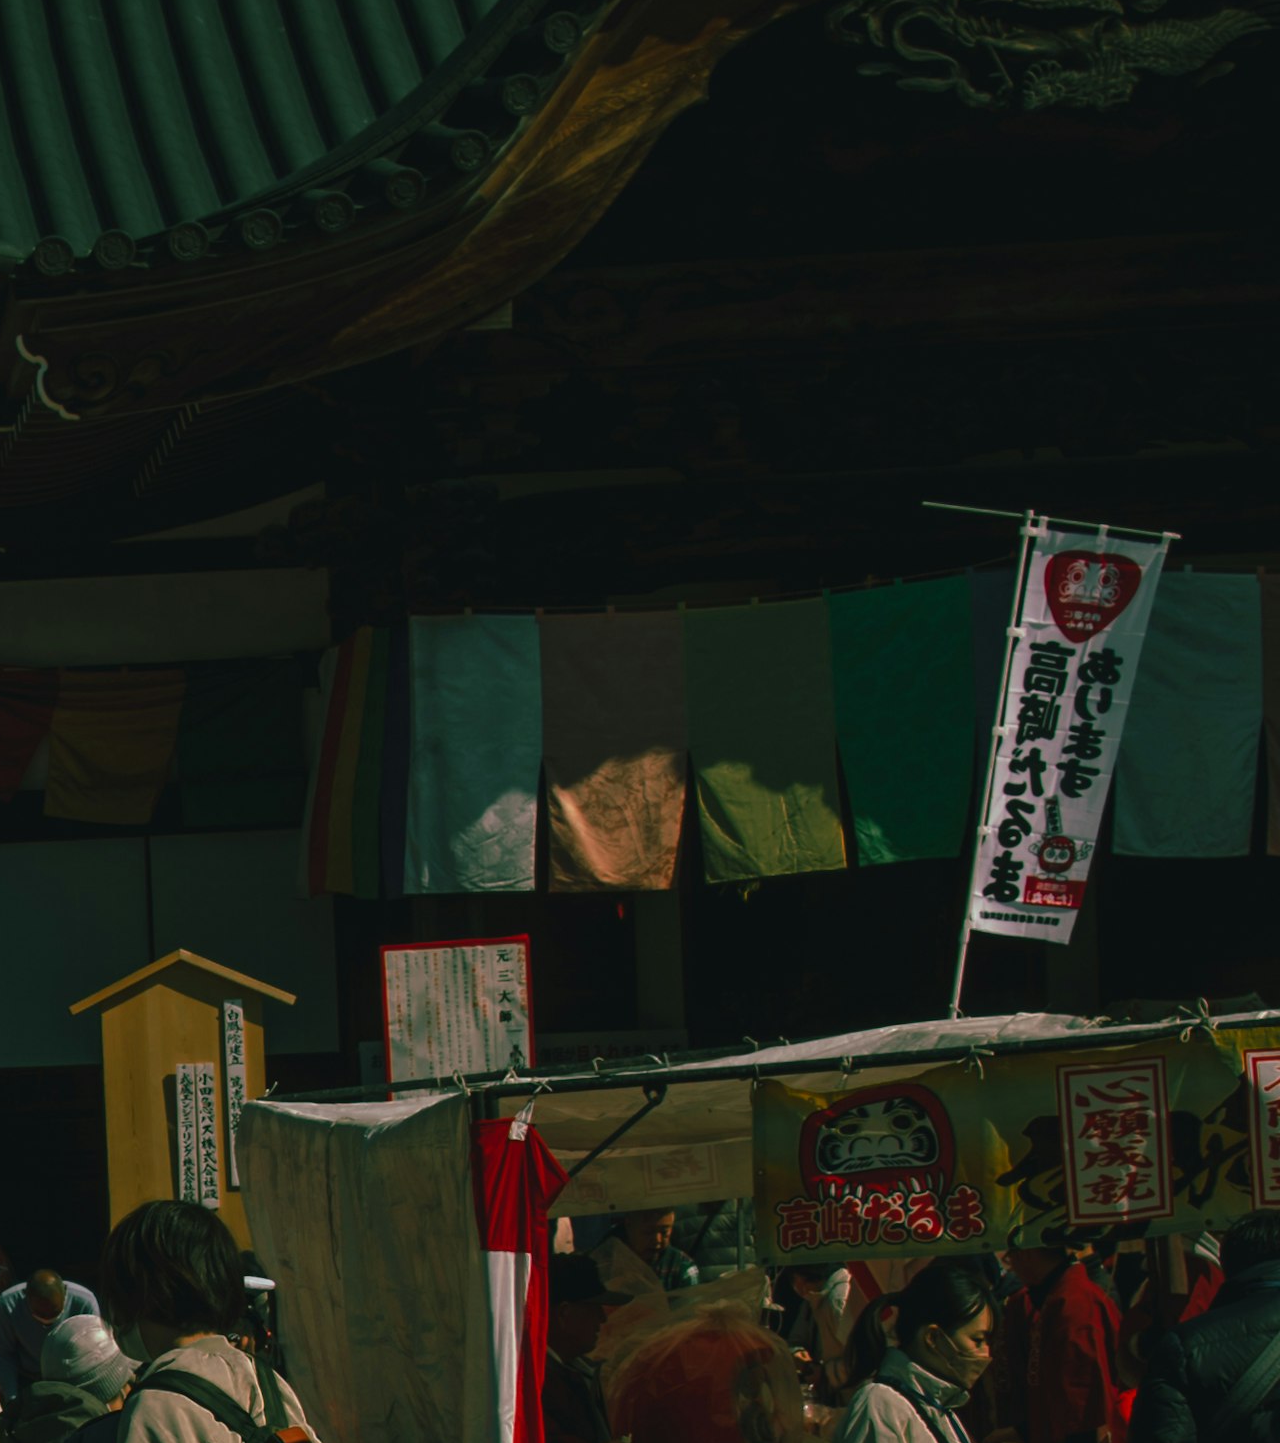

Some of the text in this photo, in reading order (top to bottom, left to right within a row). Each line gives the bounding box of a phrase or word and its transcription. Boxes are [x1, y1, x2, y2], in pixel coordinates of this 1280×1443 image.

[497, 949, 513, 1022] 元三大師
[199, 1073, 219, 1200] 小田急バス株式会社殿
[1074, 1075, 1155, 1208] 心願成就
[777, 1183, 986, 1253] 高崎だるま
